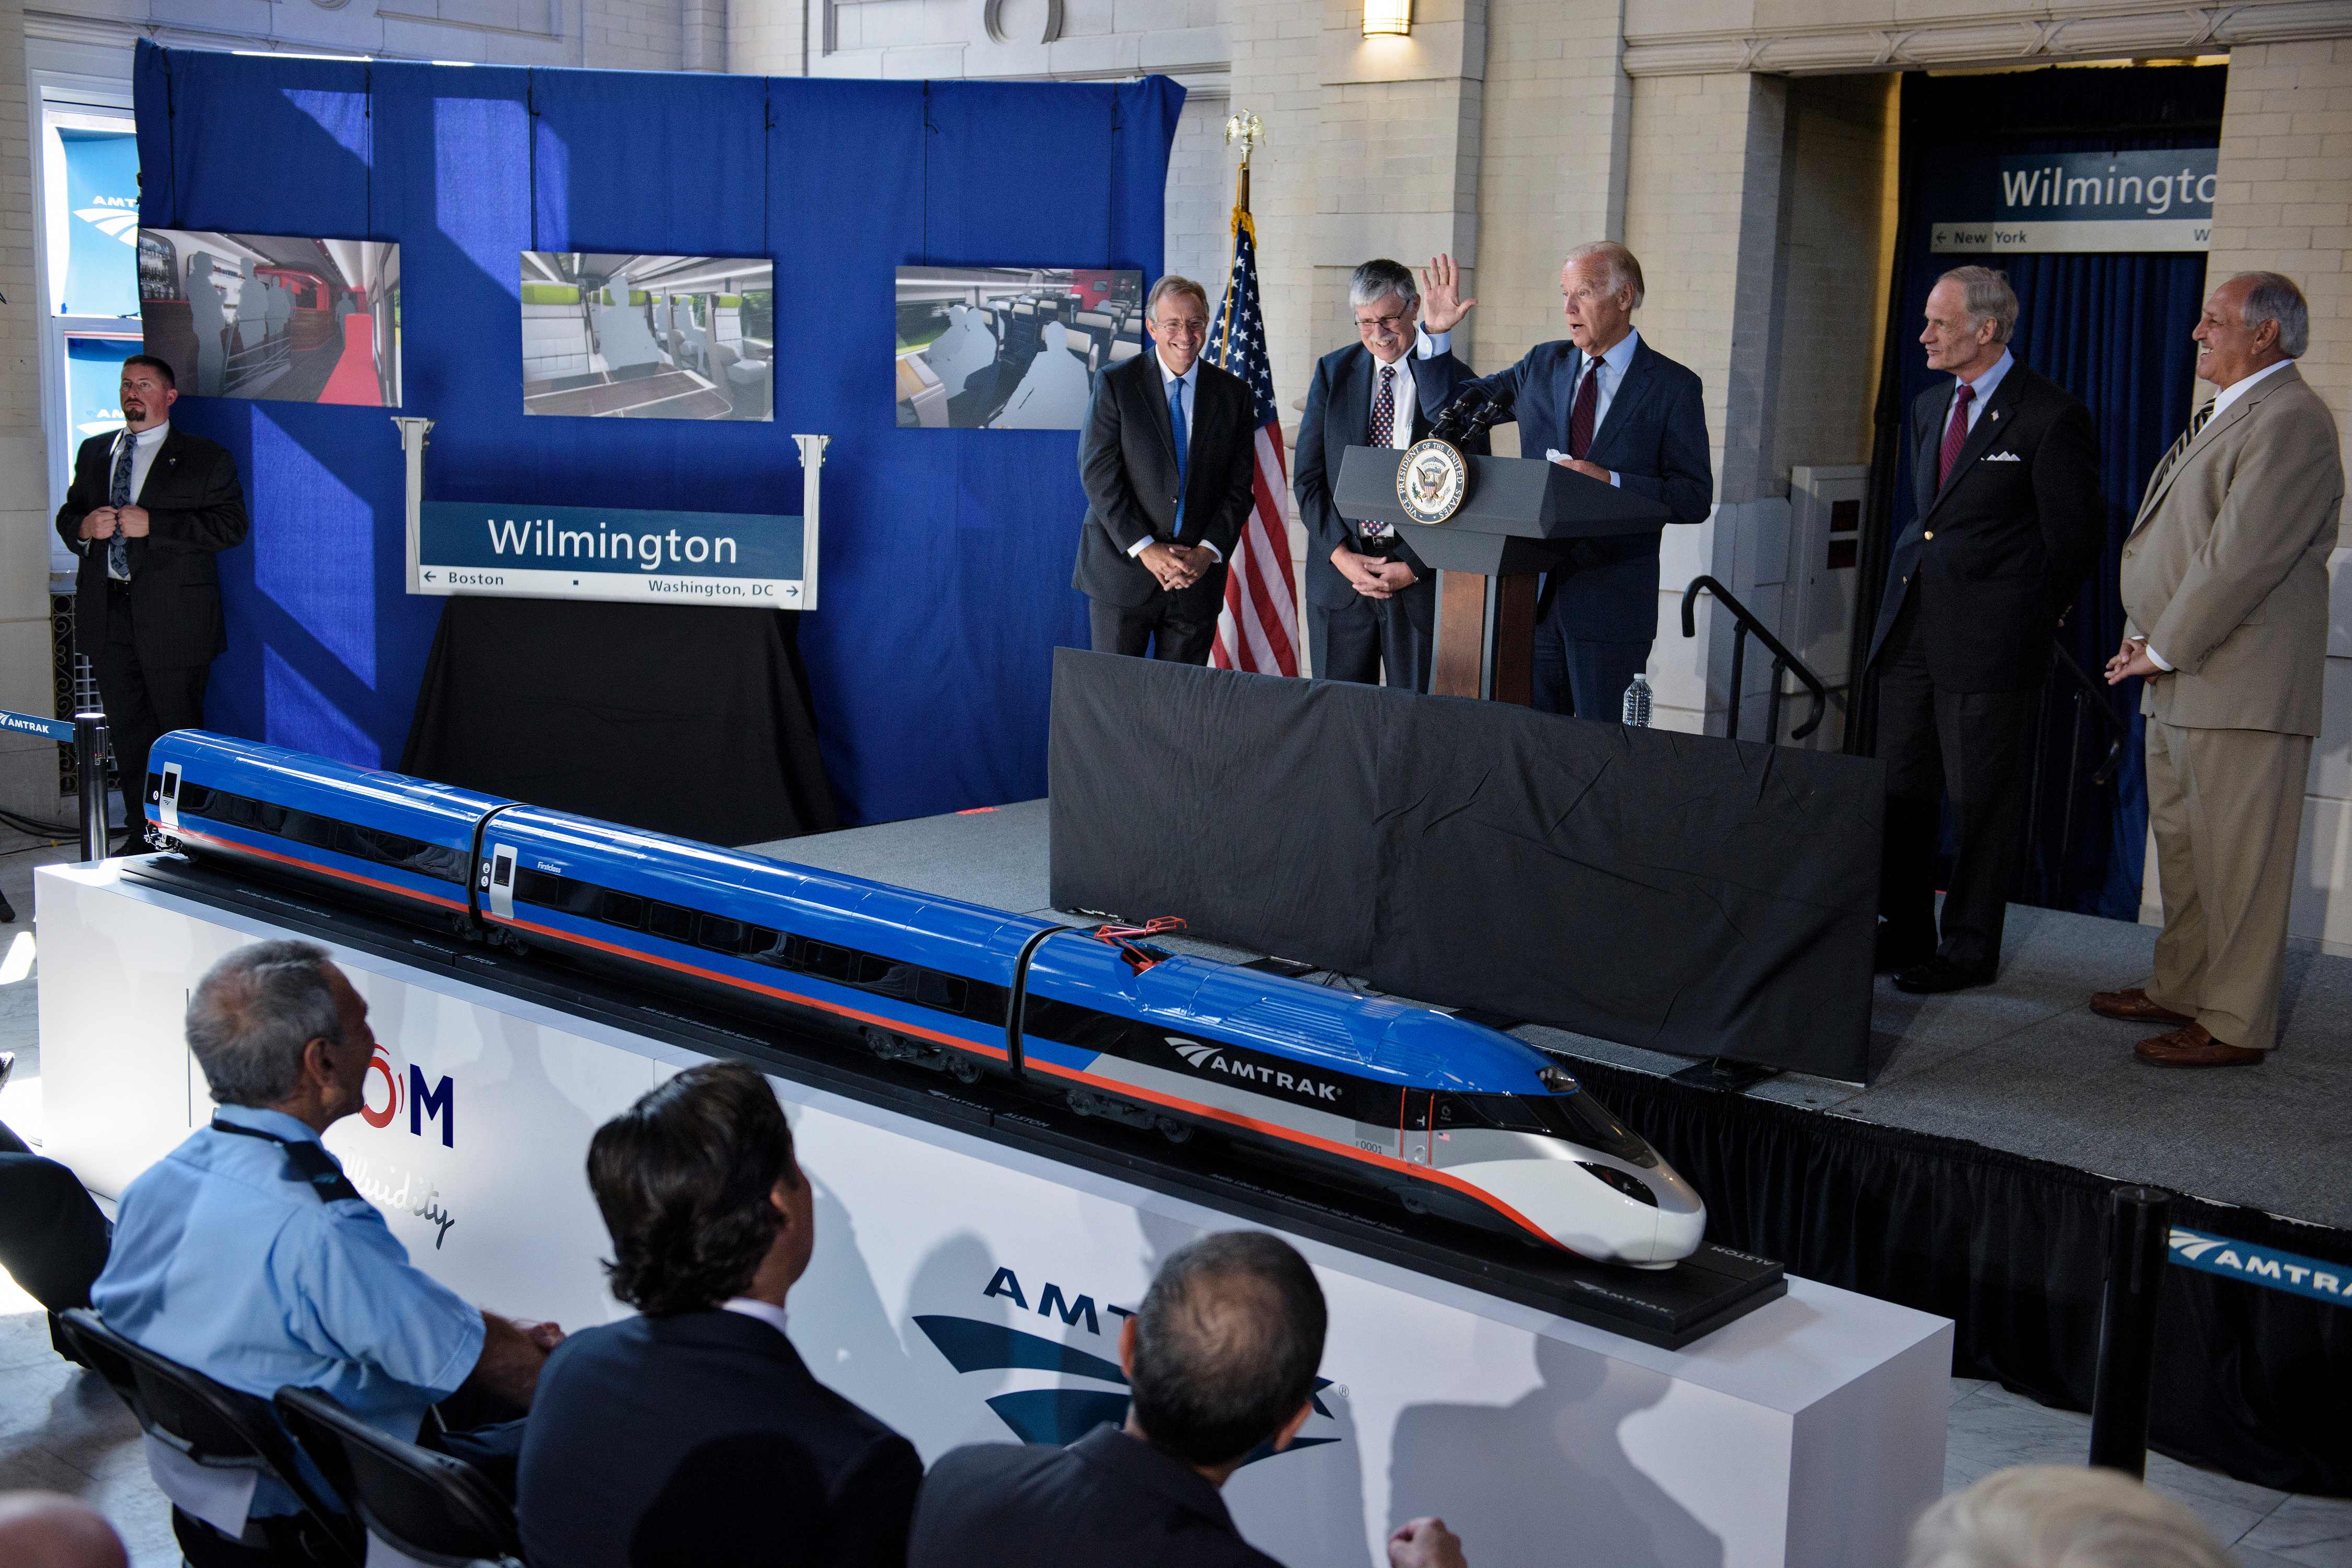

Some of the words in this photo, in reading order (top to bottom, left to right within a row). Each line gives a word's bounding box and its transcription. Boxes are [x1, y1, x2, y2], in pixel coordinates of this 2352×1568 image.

[1954, 232, 1986, 244] New
[1994, 230, 2027, 244] York
[1433, 442, 1445, 451] THE
[1399, 446, 1419, 494] PRESIDENT
[1447, 448, 1463, 484] UNITED
[1403, 497, 1417, 517] VICE
[1439, 489, 1461, 519] STATES
[488, 519, 737, 570] Wilmington
[448, 571, 505, 586] Boston
[648, 580, 746, 597] Washington,
[752, 583, 774, 597] DC
[8, 718, 50, 734] AMTRAK
[1210, 1056, 1336, 1101] AMTRAK
